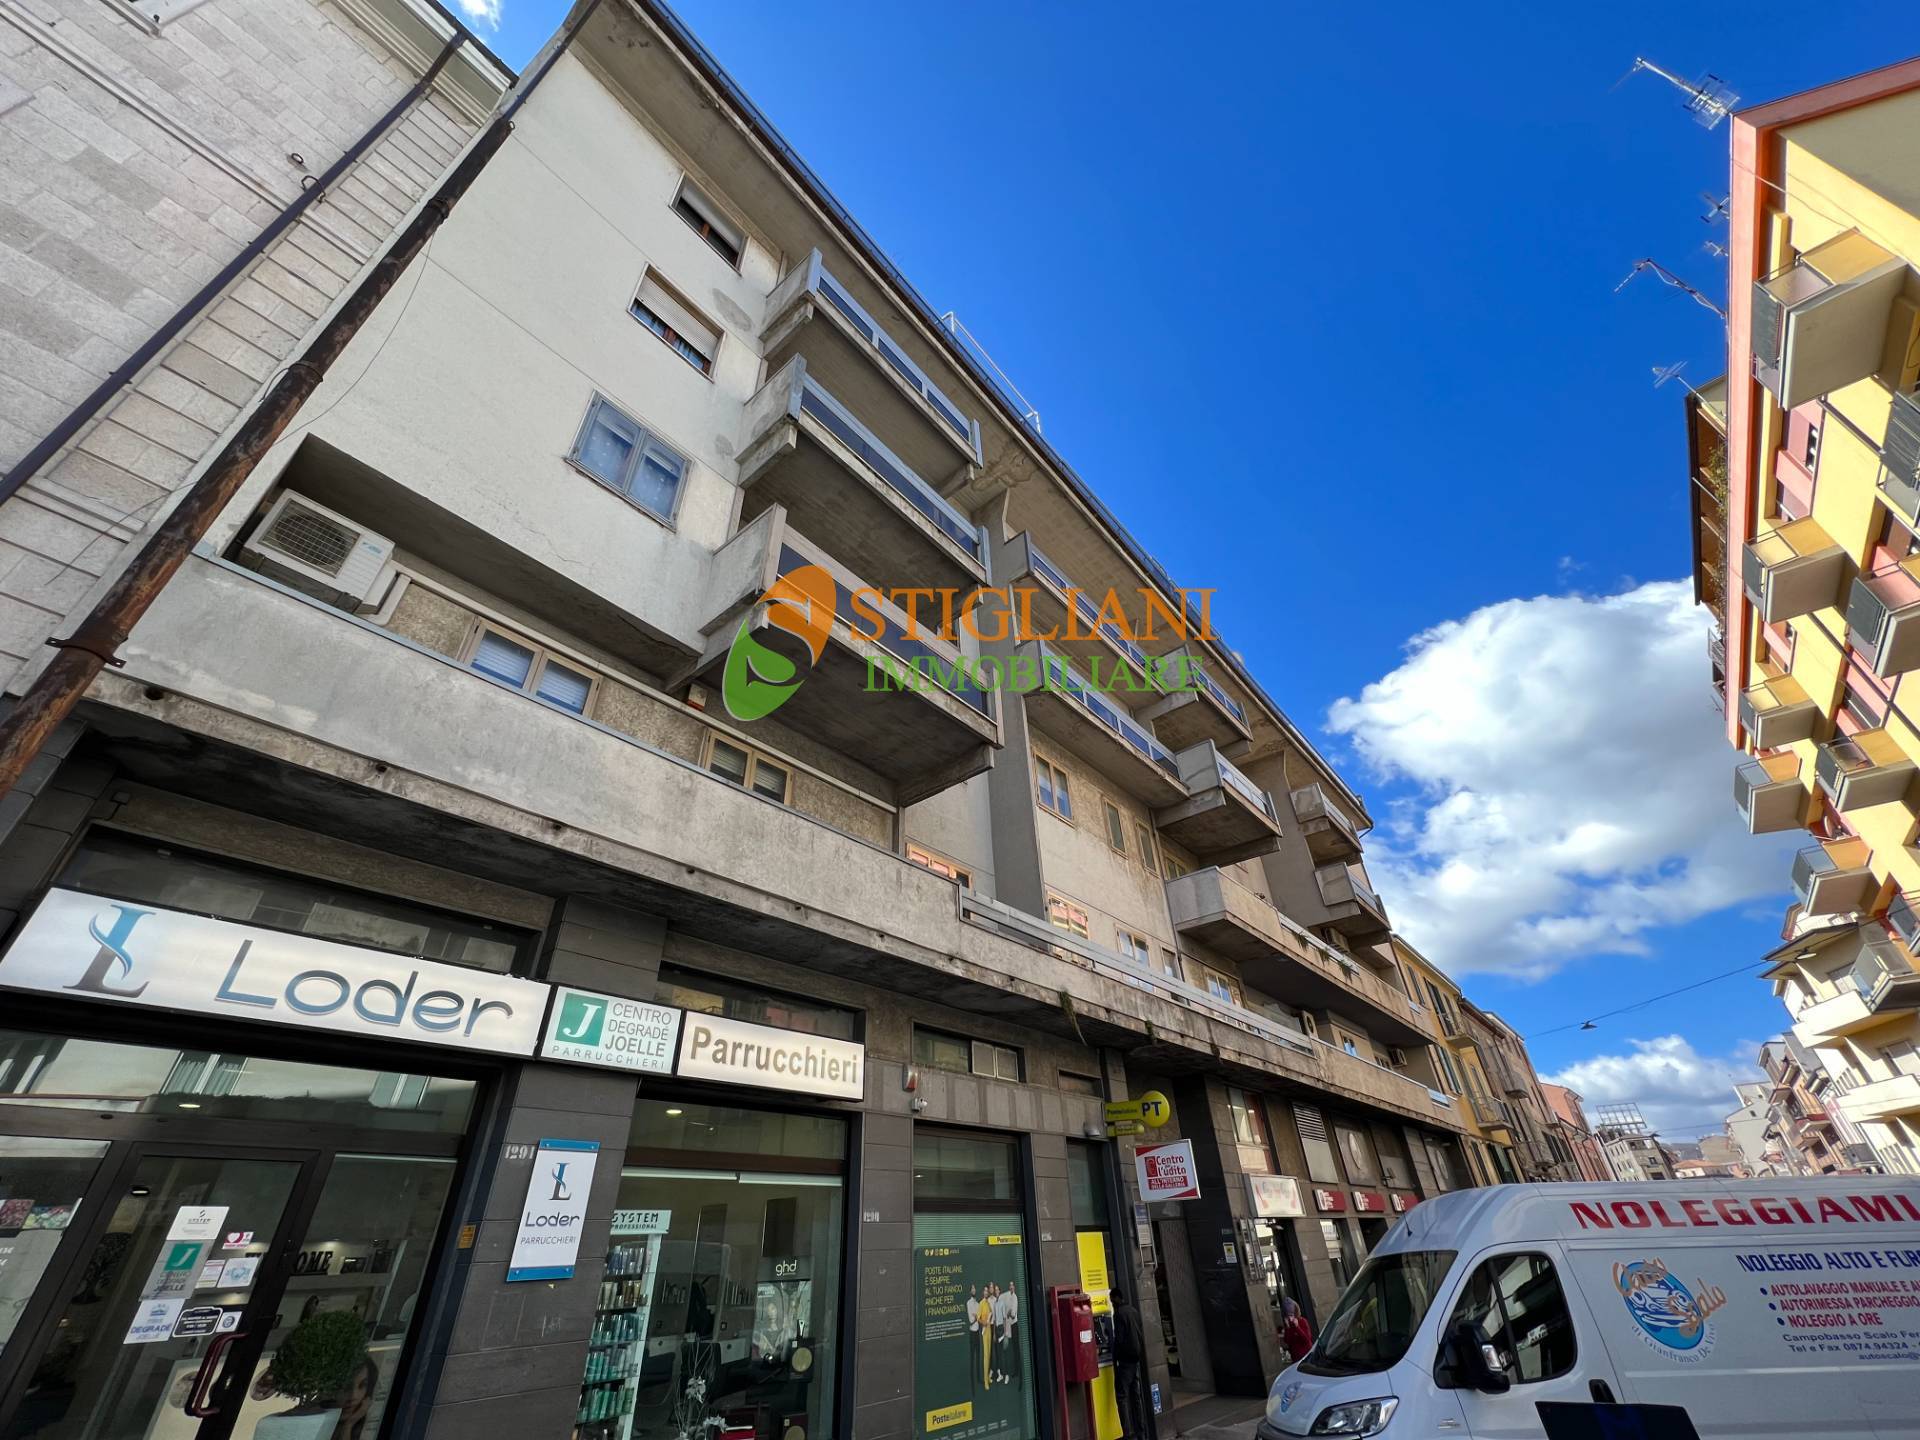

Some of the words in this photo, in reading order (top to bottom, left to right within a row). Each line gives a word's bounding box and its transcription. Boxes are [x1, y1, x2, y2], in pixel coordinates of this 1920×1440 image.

[215, 939, 514, 1037] Loder
[612, 1002, 672, 1026] CENTRO
[607, 1019, 669, 1041] DEGRADÉ
[605, 1035, 666, 1058] JOELLE
[552, 1045, 665, 1070] PARRUCCHIERI
[690, 1026, 858, 1084] Parrucchieri
[1142, 1101, 1162, 1117] PT
[1156, 1155, 1184, 1166] Centro
[525, 1211, 581, 1228] Loder
[612, 1212, 659, 1224] SYSTEM
[1569, 1193, 1920, 1230] NOLEGGIAMI
[520, 1235, 577, 1245] PARRUCCHIERI
[776, 1260, 797, 1276] ghd
[1736, 1253, 1823, 1272] NOLEGGIO
[1824, 1251, 1873, 1270] AUTO
[1871, 1251, 1888, 1268] E
[925, 1266, 942, 1275] POSTE
[942, 1265, 963, 1274] ITALIANE
[929, 1275, 950, 1285] SEMPRE
[933, 1286, 944, 1295] TUO
[1770, 1282, 1850, 1297] AUTOLAVAGGIO
[1849, 1281, 1900, 1294] MANUALE
[1900, 1280, 1910, 1292] E
[943, 1295, 954, 1304] PER
[1780, 1297, 1852, 1312] AUTORIMESSA
[1854, 1295, 1920, 1310] PARCHEGGIO
[1787, 1313, 1846, 1328] NOLEGGIO
[1848, 1313, 1858, 1326] A
[1858, 1312, 1884, 1326] ORE
[1783, 1332, 1861, 1343] Campobasso
[1863, 1331, 1897, 1340] Scalo
[1644, 1337, 1699, 1363] Gianfranco
[1788, 1344, 1807, 1353] Tel
[1819, 1343, 1841, 1352] Fax
